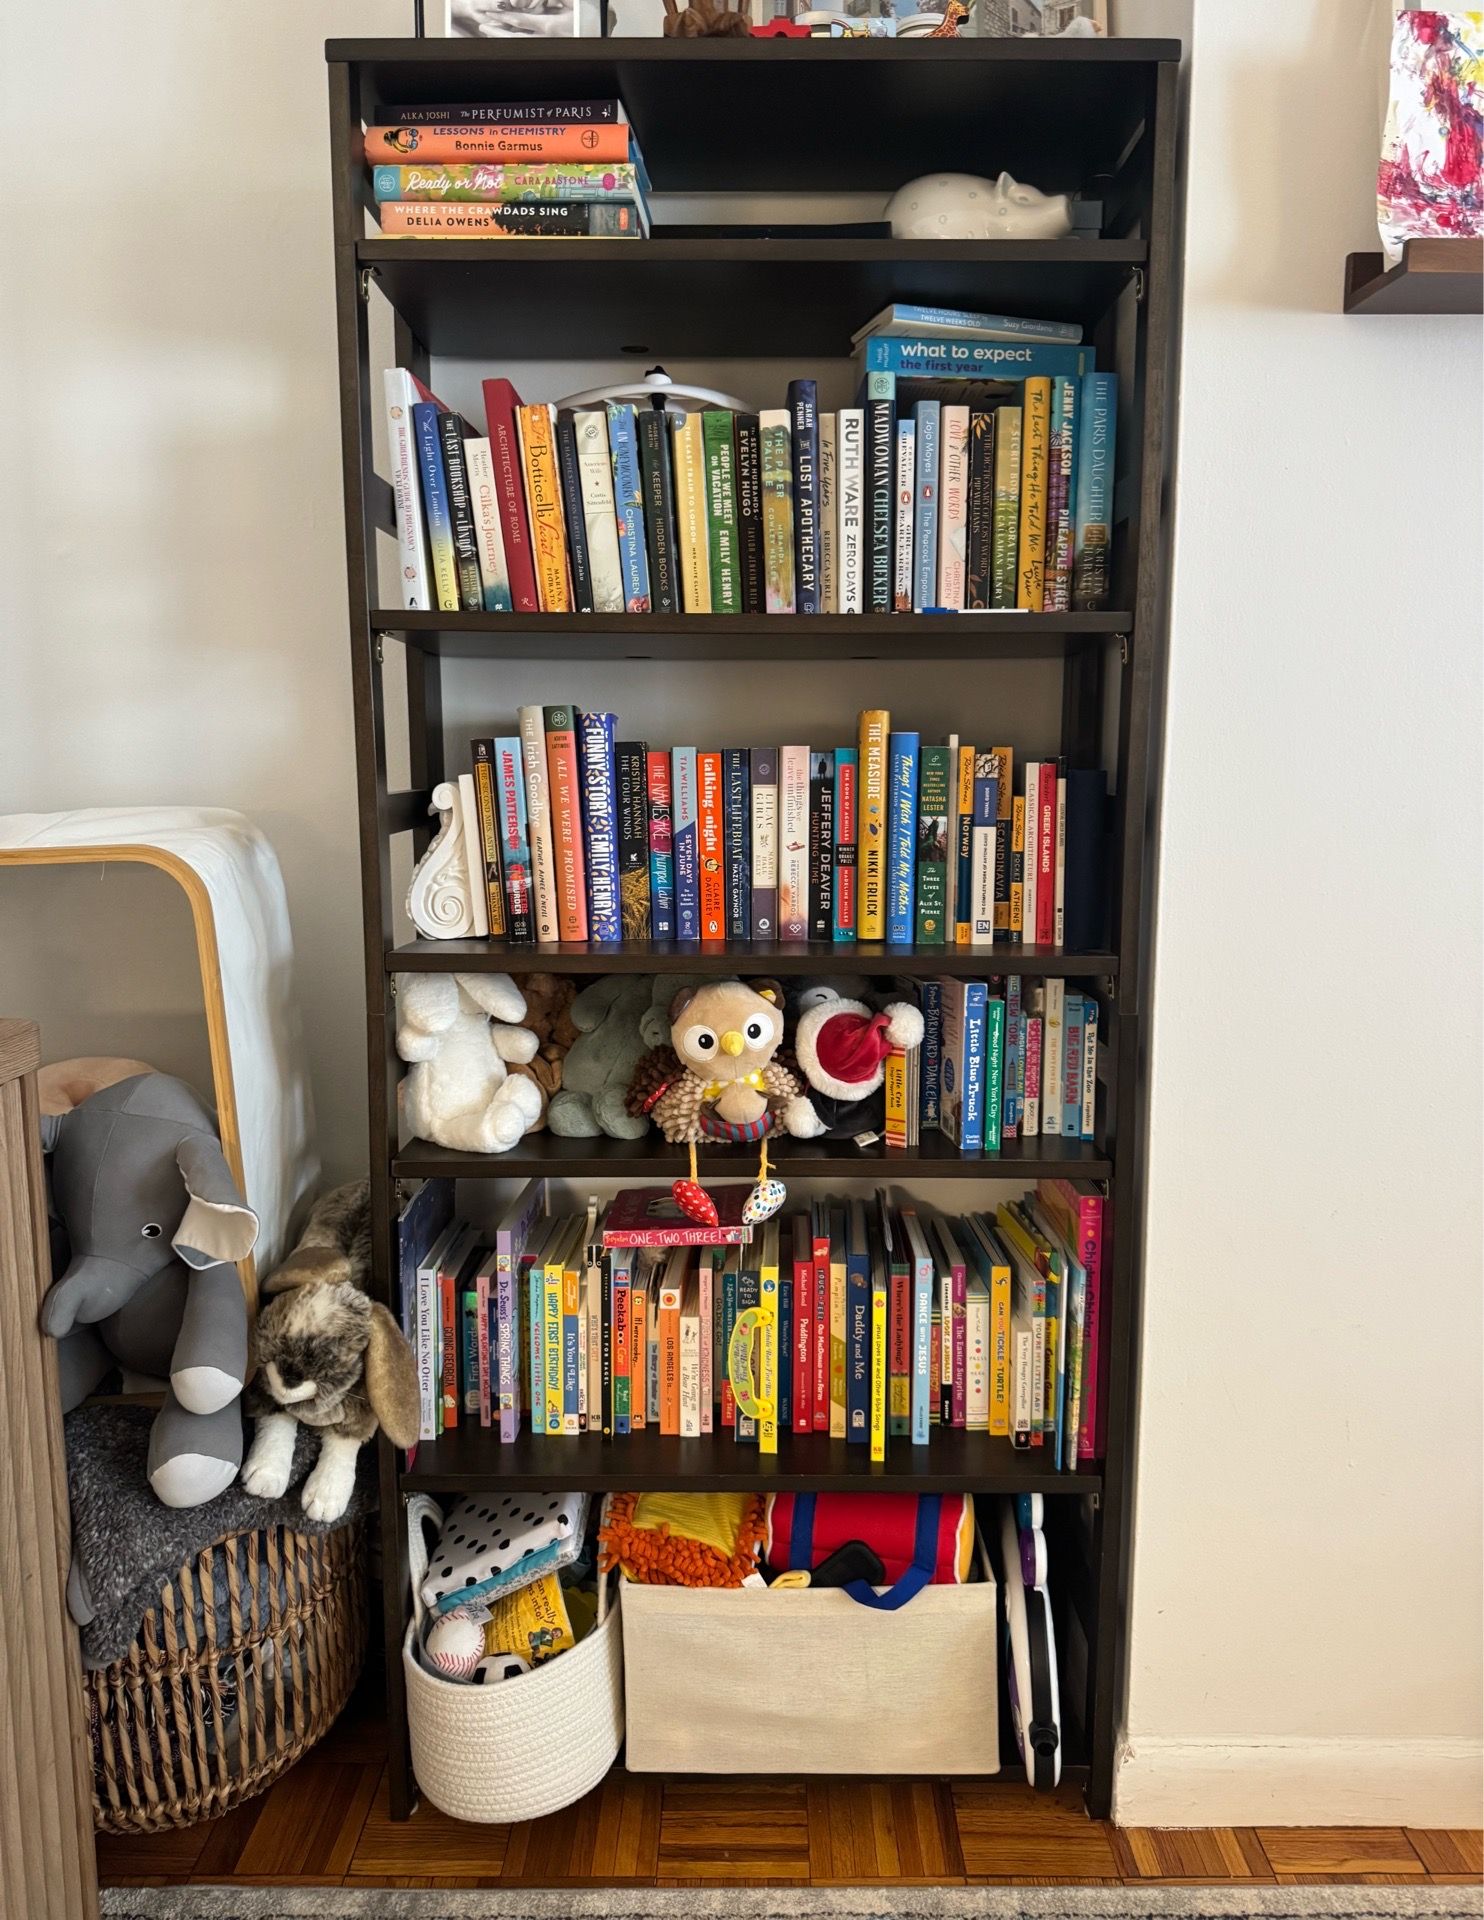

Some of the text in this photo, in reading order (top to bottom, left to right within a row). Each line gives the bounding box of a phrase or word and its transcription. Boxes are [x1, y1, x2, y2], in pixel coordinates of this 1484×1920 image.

[401, 112, 424, 120] ALKA
[472, 108, 544, 120] PERFUMIST
[556, 107, 591, 118] PARIS
[456, 141, 543, 151] Bonnie Garmus
[406, 172, 502, 194] Ready or Not
[515, 176, 589, 185] CARA BASTONE
[395, 206, 435, 214] WHERE
[468, 207, 535, 216] CRAWDADS
[539, 208, 567, 216] SING
[407, 217, 489, 226] DELIA OWENS
[901, 343, 1032, 362] what to expect
[901, 360, 983, 372] the first year
[924, 420, 934, 472] Jojo Moyes
[1061, 382, 1074, 475] JENNY JACKSON
[1090, 380, 1107, 520] THE PARIS DAUGHTER
[480, 451, 488, 477] Heather
[497, 424, 520, 544] ARCHITECTURE OF ROME
[712, 456, 722, 516] ON VACATION
[720, 444, 733, 525] PEOPLE WE MEET
[740, 431, 751, 516] EVELYN HUGO
[845, 419, 859, 527] RUTH WARE
[479, 485, 499, 575] Cilka's Journey
[800, 456, 814, 591] LOST APOTHECARY
[872, 403, 889, 604] MADWOMAN CHELSEA BIEKER
[626, 509, 640, 594] CHRISTINA LAUREN
[719, 530, 732, 605] EMILY HENRY
[847, 534, 855, 601] ZERO DAYS
[920, 512, 931, 607] The Peacock Emporium
[525, 718, 541, 827] THE Irish Goodbye
[586, 728, 608, 818] FUNNY STORY
[702, 758, 716, 808] talking
[732, 772, 742, 802] LAST
[868, 723, 881, 799] THE MEASURE
[503, 751, 518, 849] JAMES PATTERSON
[622, 777, 630, 803] FOUR
[632, 756, 641, 838] KRISTIN HANNAH
[652, 766, 670, 840] THE NAMESAKE
[680, 773, 688, 820] WILLIAMS
[557, 758, 576, 910] ALL WE WERE PROMISED
[679, 843, 685, 851] IN
[702, 816, 718, 852] night
[732, 804, 742, 860] LIFEBOAT
[820, 787, 831, 909] JEFFERY DEAVER
[961, 817, 970, 857] Norway
[996, 822, 1005, 898] SCANDINAVIA
[1042, 806, 1051, 872] GREEK ISLANDS
[591, 835, 612, 916] EMILY HENRY
[867, 850, 878, 916] NIKKI ERLICK
[926, 1008, 939, 1100] BARNYARD DANCE!
[968, 1020, 980, 1120] Little Blue Truck
[989, 1106, 997, 1118] City
[630, 1230, 721, 1245] ONE, TWO, THREE!
[421, 1285, 429, 1306] Love
[421, 1309, 429, 1325] You
[853, 1306, 864, 1341] Daddy
[920, 1293, 928, 1323] DANCE
[421, 1329, 430, 1348] Like
[422, 1352, 430, 1364] No
[444, 1327, 454, 1386] GOING GEORGIA
[500, 1281, 510, 1384] Dr. Seuss's SPRING THINGS
[547, 1293, 559, 1390] HAPPY FIRST BIRTHDAY!
[798, 1319, 808, 1362] Paddington
[918, 1345, 927, 1374] JESUS
[422, 1367, 430, 1392] Otter
[855, 1362, 864, 1379] Me
